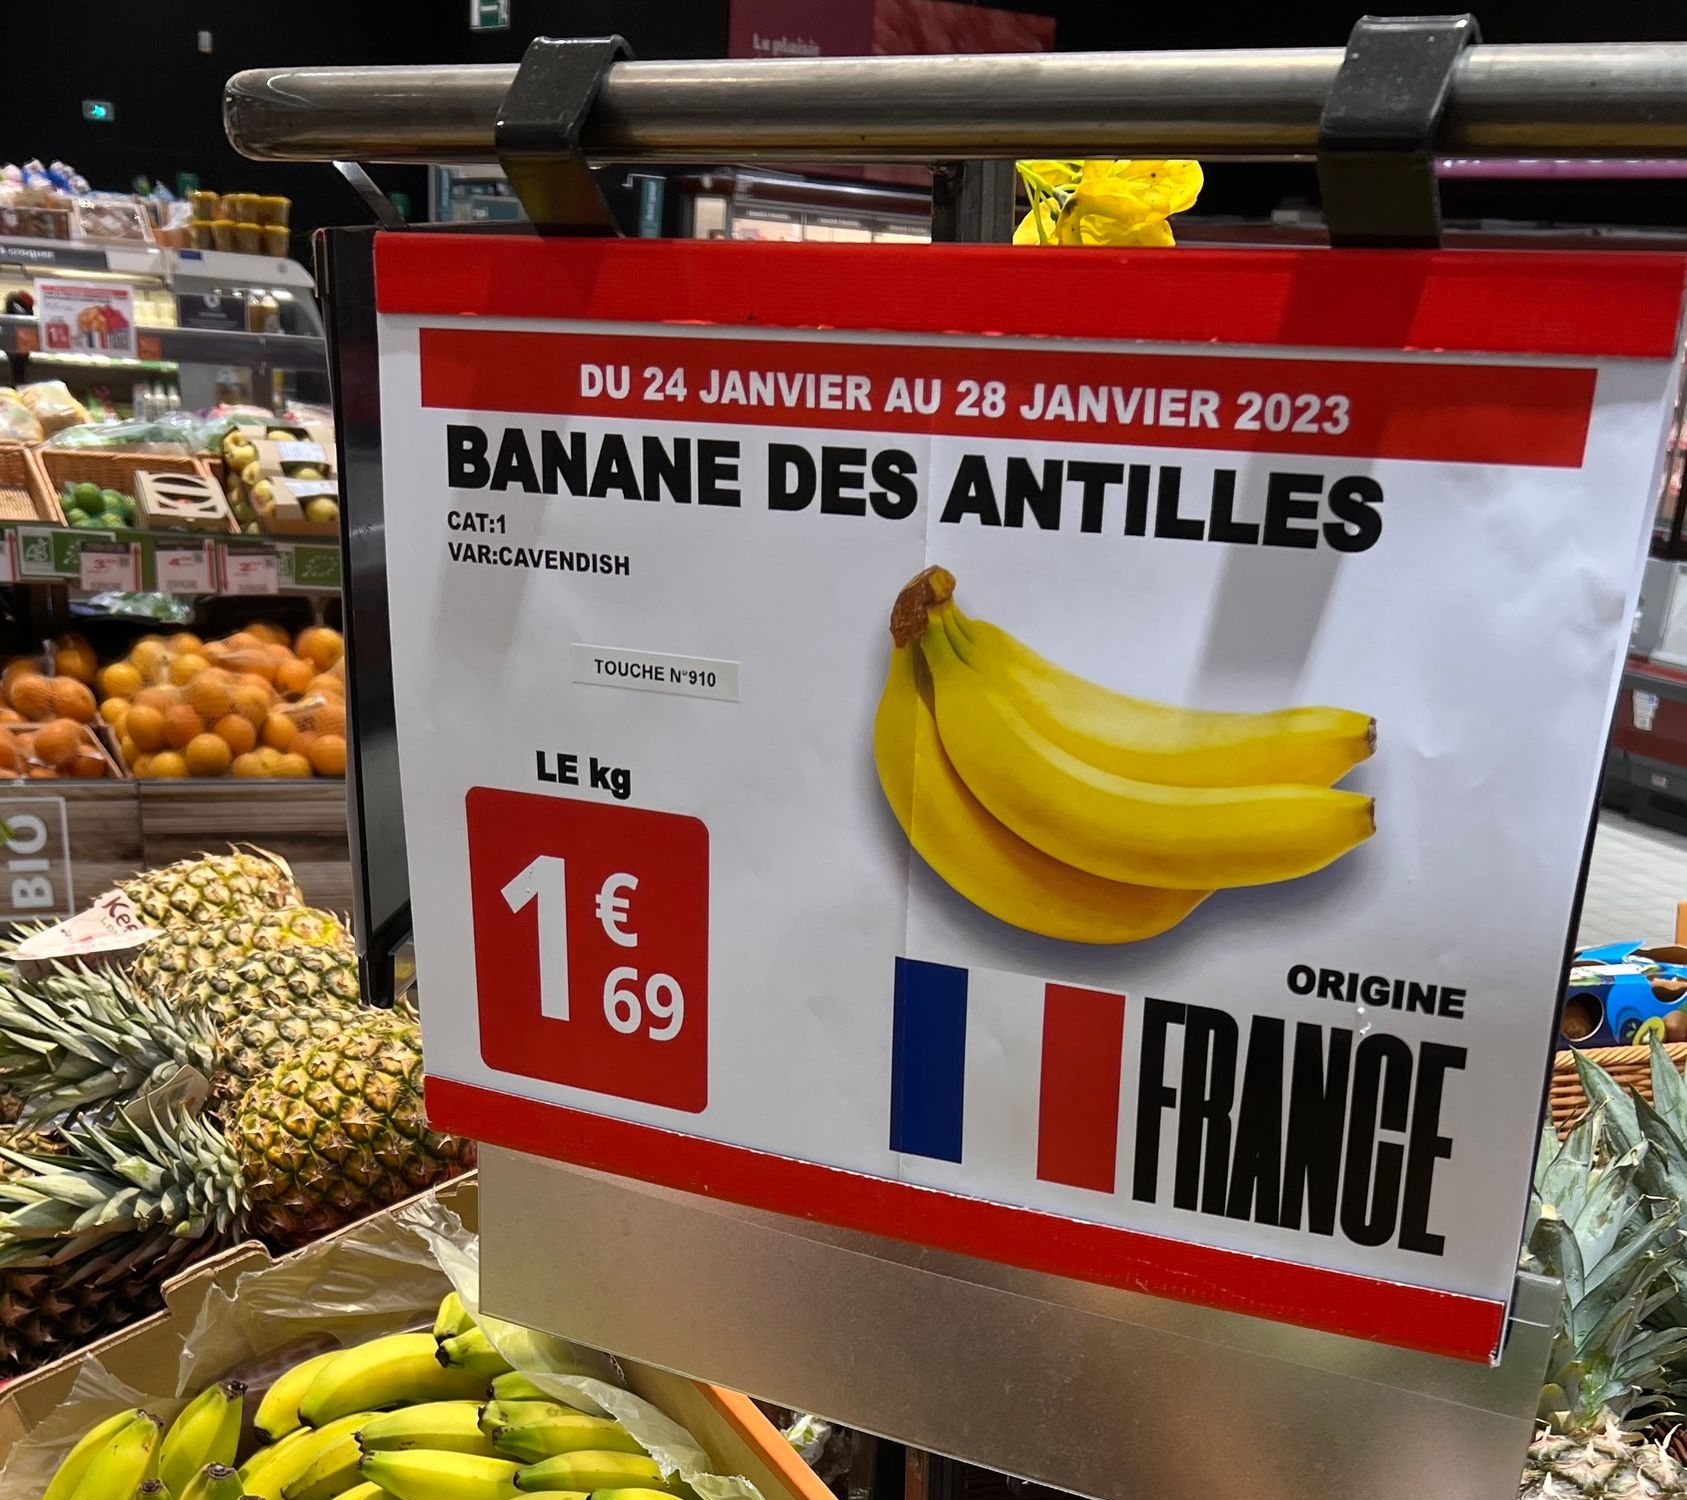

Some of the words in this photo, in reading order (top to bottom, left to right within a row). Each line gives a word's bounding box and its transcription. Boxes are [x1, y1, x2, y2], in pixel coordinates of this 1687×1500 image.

[580, 363, 630, 399] DU
[643, 366, 688, 402] 24
[699, 368, 872, 412] JANVIER
[884, 377, 942, 415] AU
[955, 379, 1007, 419] 28
[1020, 383, 1221, 429] JANVIER
[1234, 391, 1351, 435] 2023
[446, 424, 742, 508] BANANE
[768, 442, 919, 520] DES
[939, 454, 1385, 553] ANTILLES
[447, 510, 507, 535] CAT:1
[447, 542, 630, 576] VAR:CAVENDISH
[594, 658, 665, 683] TOUCHE
[535, 750, 579, 786] LE
[589, 757, 631, 800] kg
[5, 814, 54, 909] BIO
[500, 855, 570, 1022] 1
[595, 872, 640, 948] €
[603, 966, 685, 1042] 69
[1287, 964, 1466, 1020] ORIGINE
[1132, 997, 1468, 1257] FRANCE
